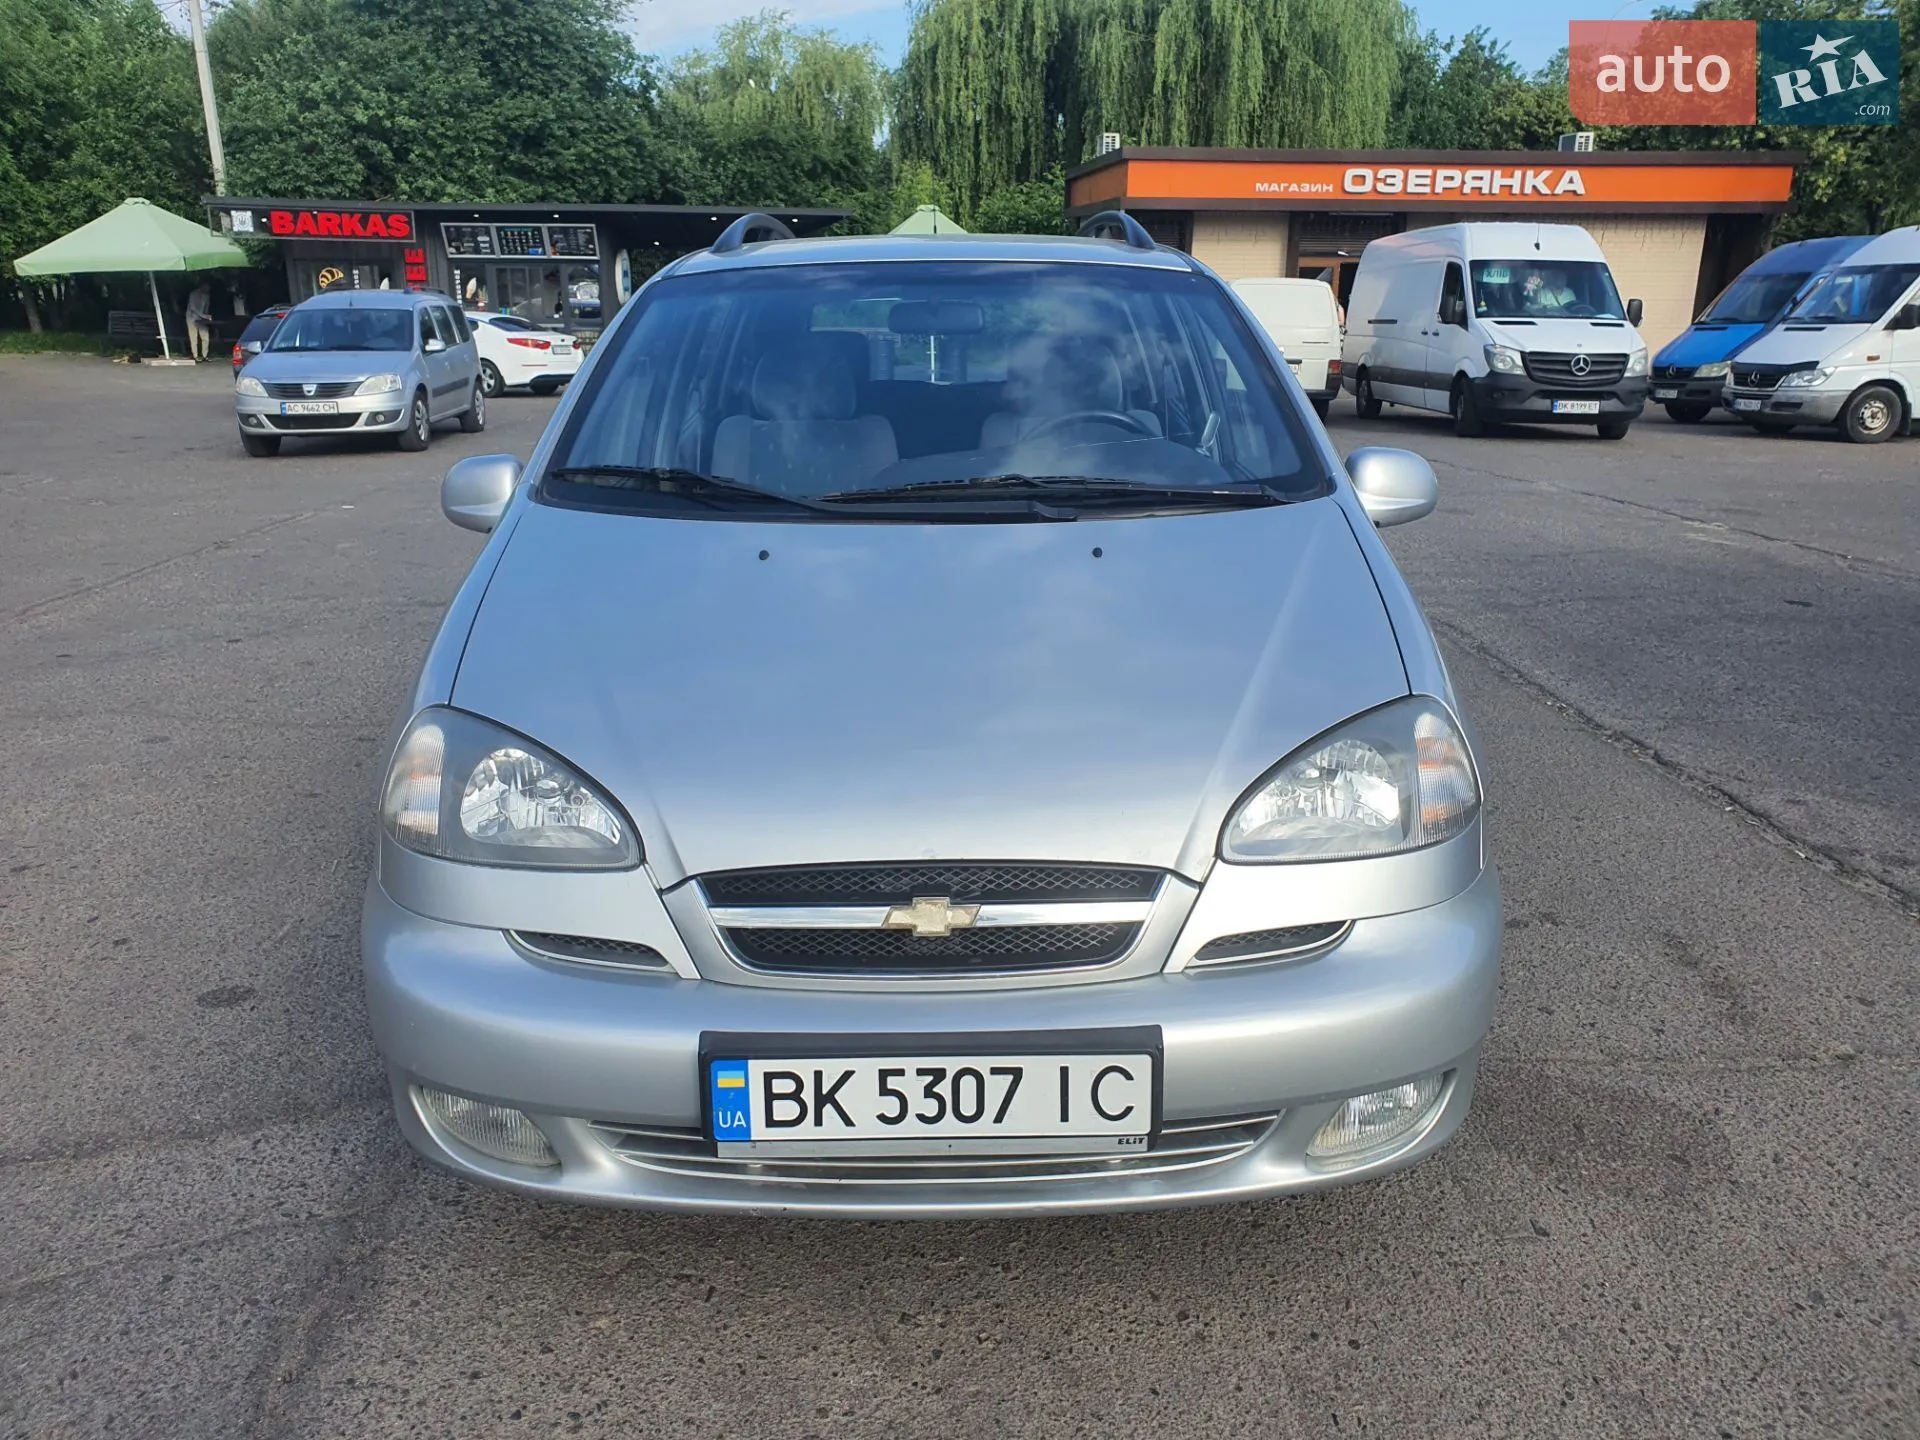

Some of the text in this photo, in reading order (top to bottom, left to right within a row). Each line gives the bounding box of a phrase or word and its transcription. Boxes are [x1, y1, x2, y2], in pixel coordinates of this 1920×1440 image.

[1255, 168, 1586, 195] МАГАЗИН ОЗЕРЯНКА
[270, 210, 410, 238] BARKAS
[718, 1111, 747, 1129] UA
[762, 1068, 857, 1128] BK
[875, 1065, 1024, 1126] 5307
